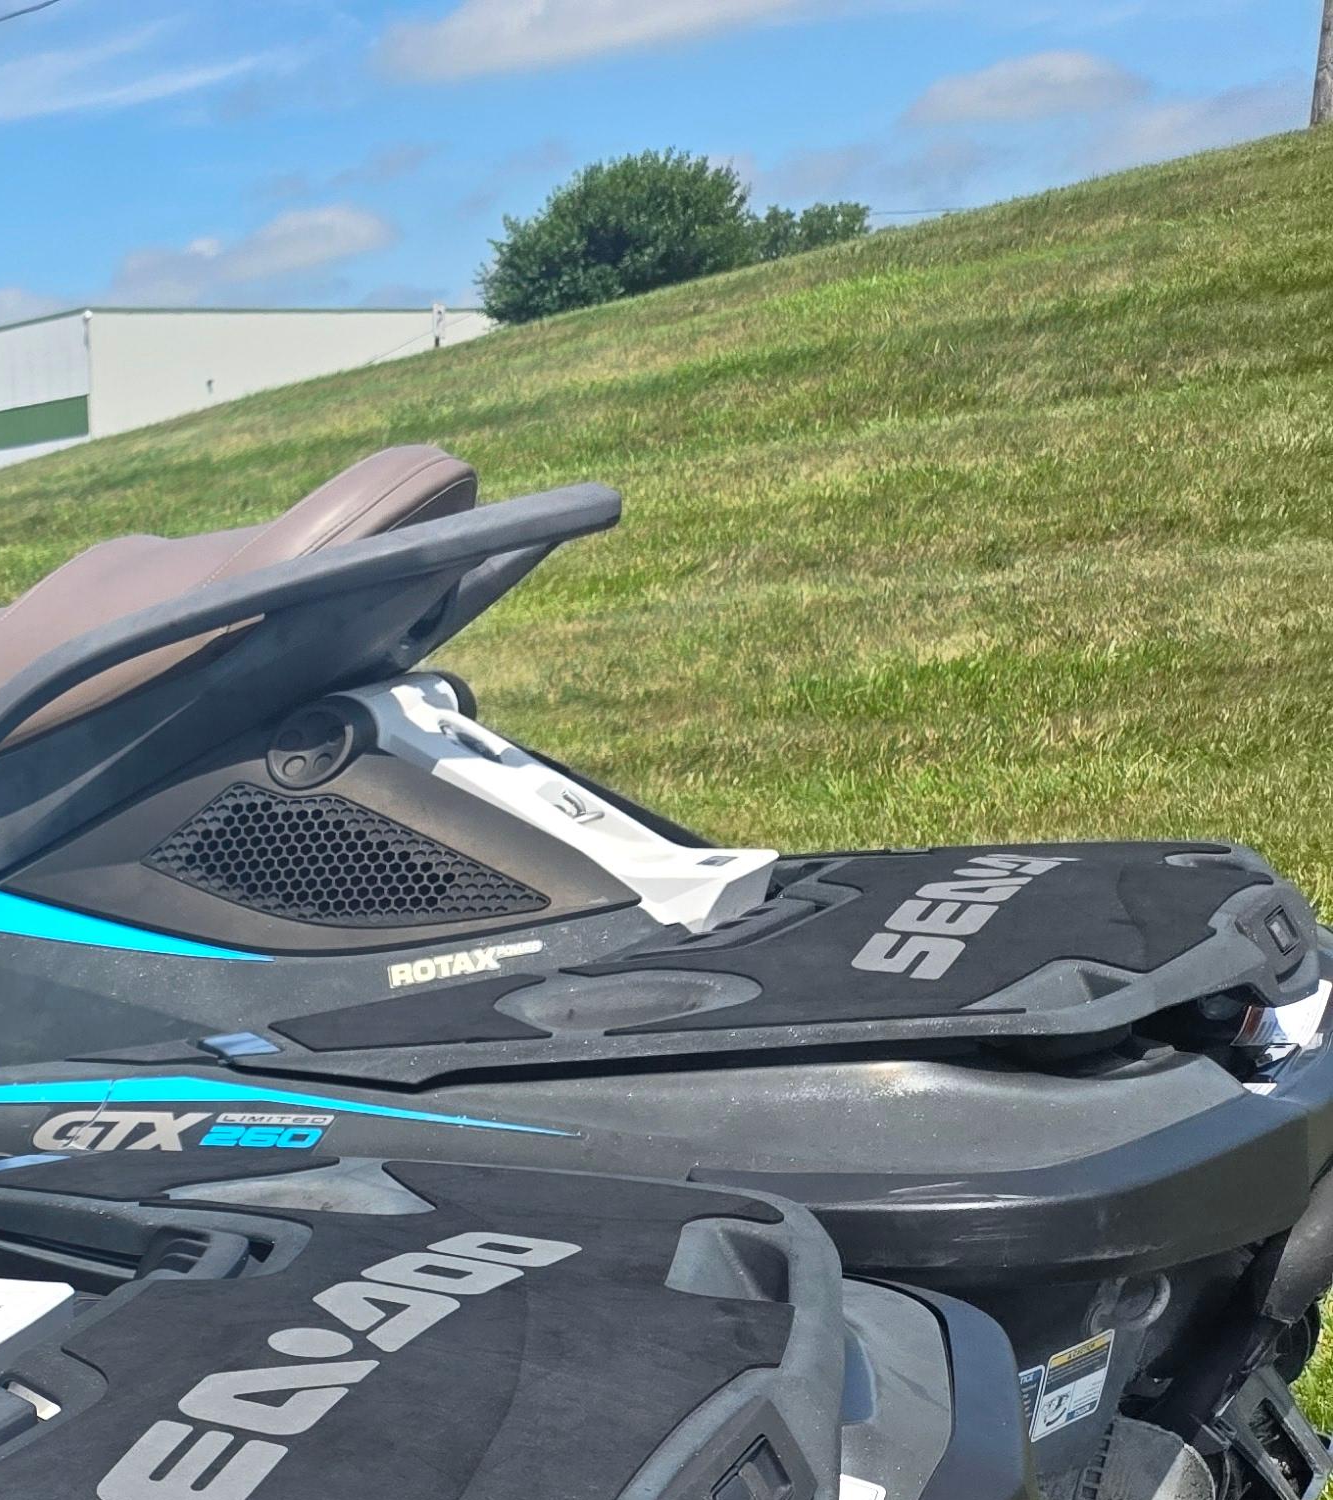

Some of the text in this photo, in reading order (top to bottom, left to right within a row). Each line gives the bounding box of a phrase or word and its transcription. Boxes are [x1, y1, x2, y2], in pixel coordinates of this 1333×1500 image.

[388, 948, 501, 988] ROTAX
[33, 1110, 214, 1151] GTX
[223, 1114, 328, 1124] LIMITED
[198, 1126, 324, 1148] 260
